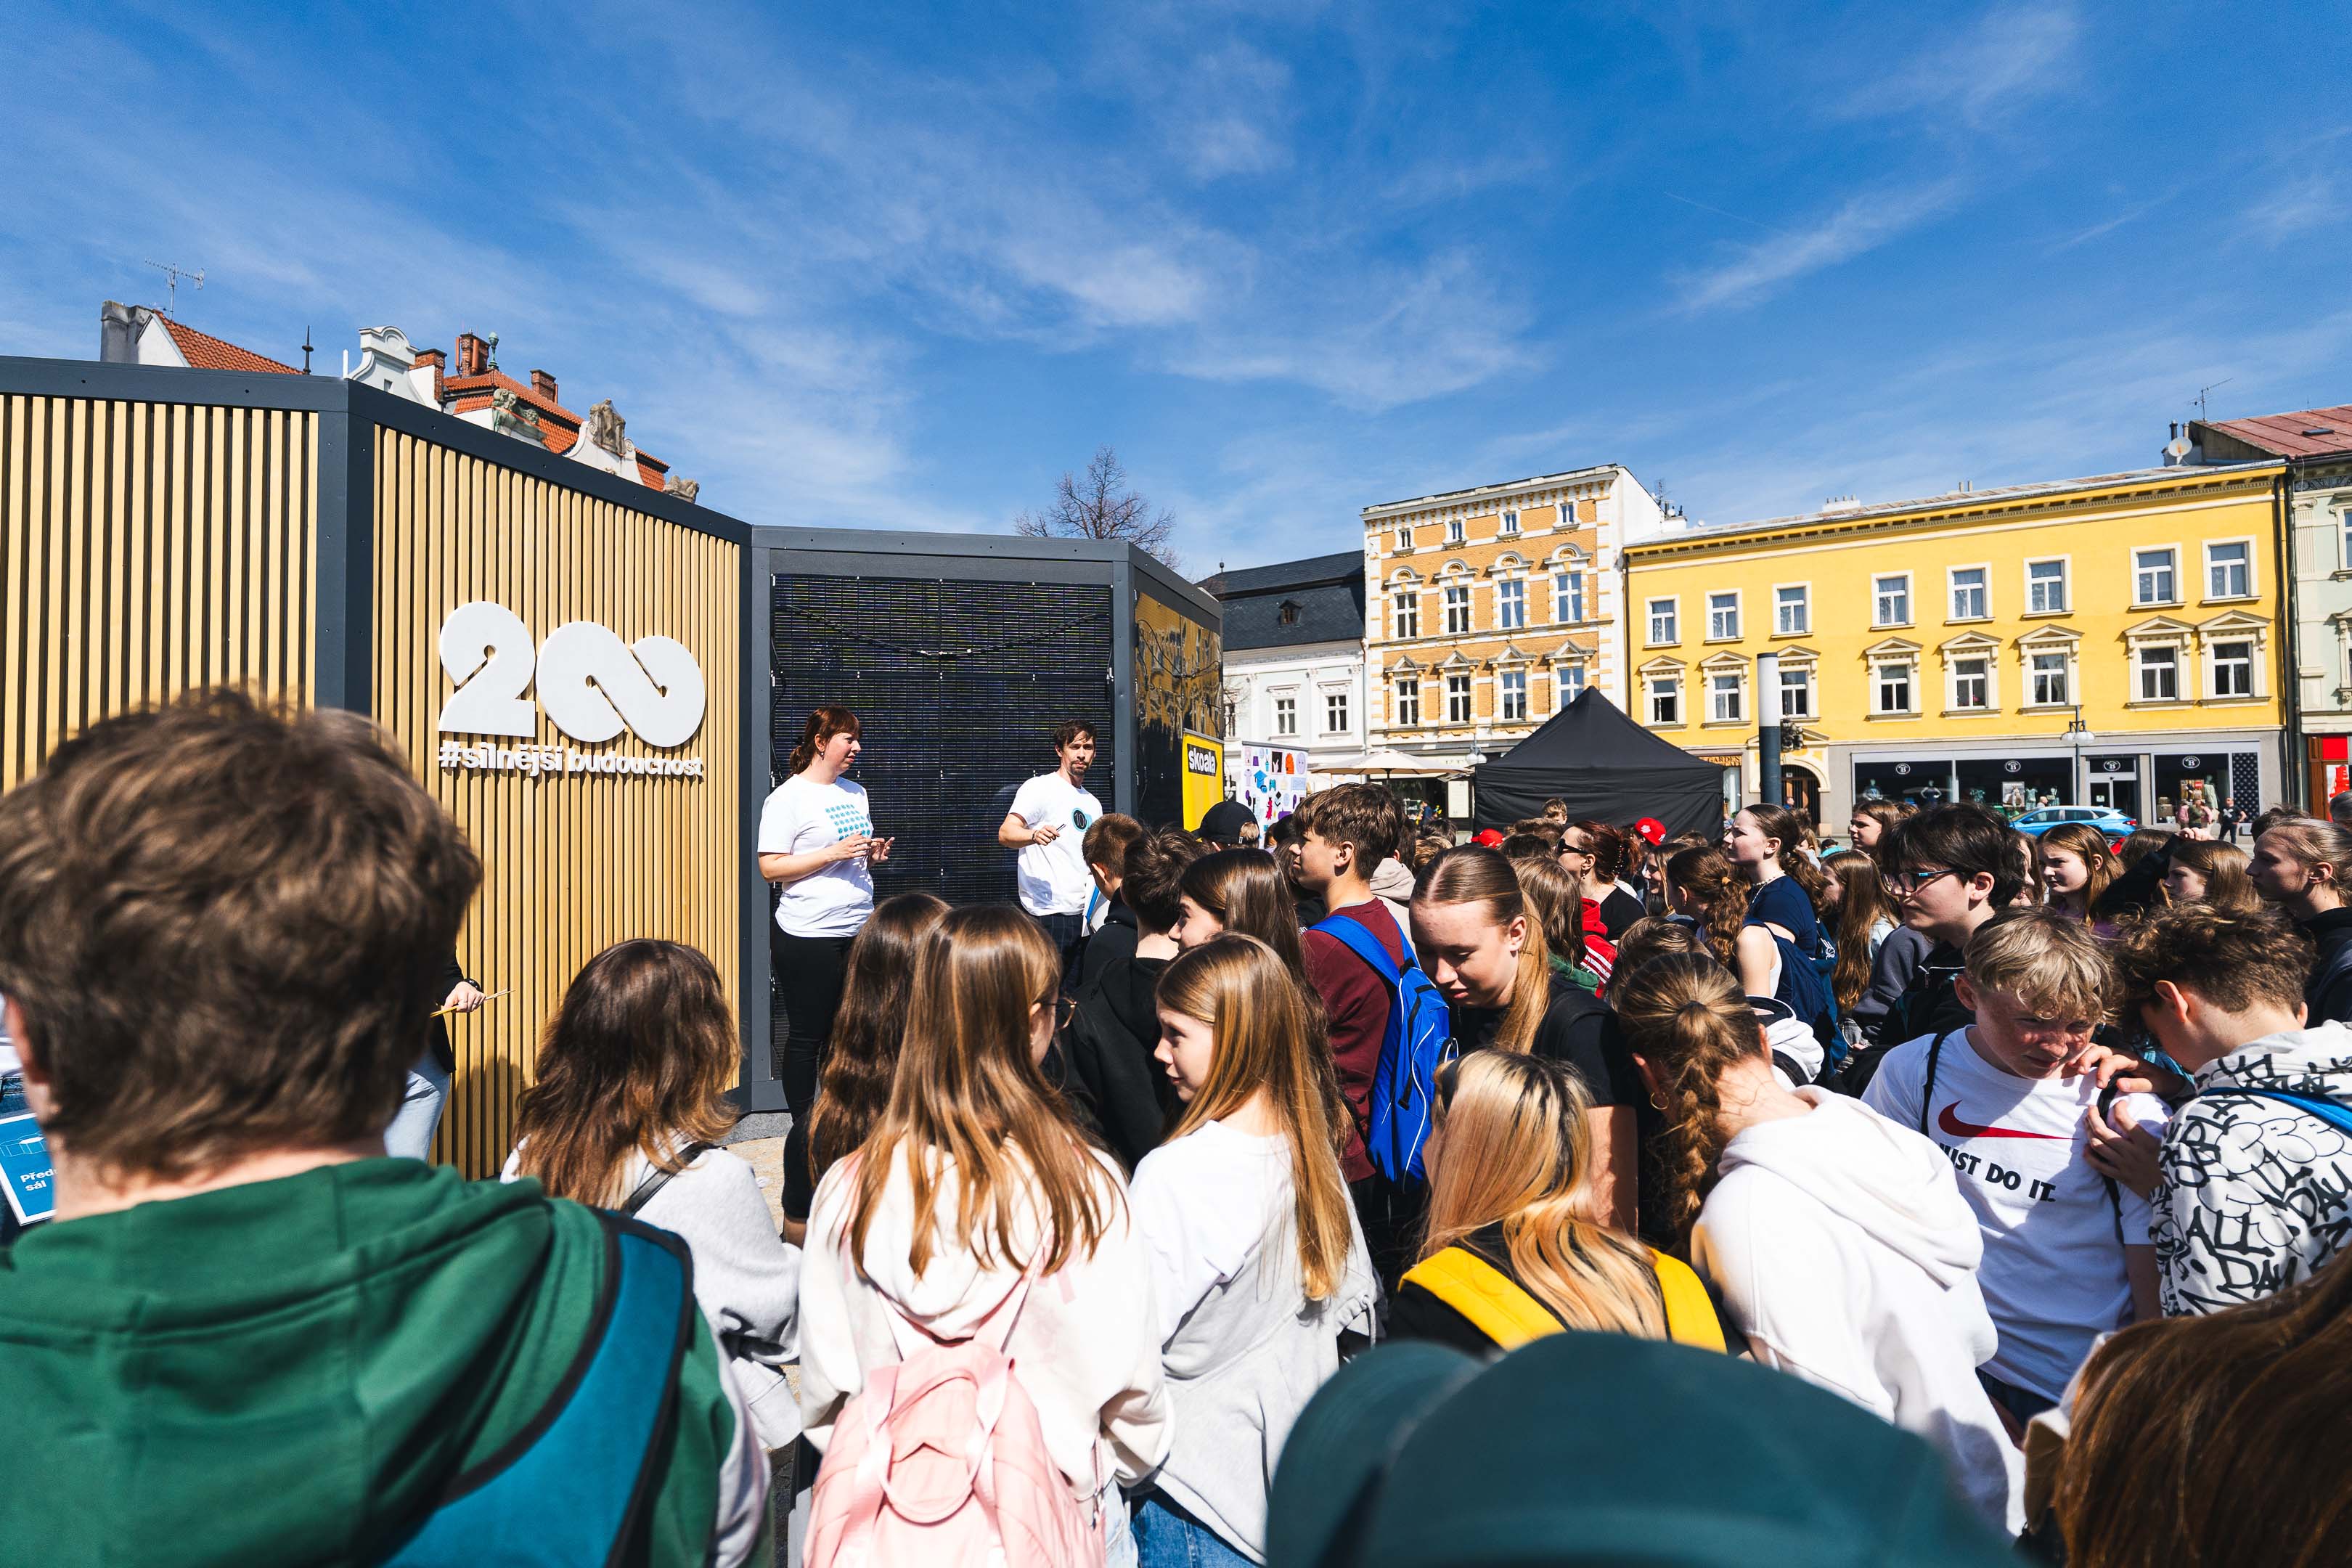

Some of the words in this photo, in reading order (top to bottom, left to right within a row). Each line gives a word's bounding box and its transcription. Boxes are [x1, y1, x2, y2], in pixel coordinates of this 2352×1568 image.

[568, 749, 703, 777] budoucnost
[1188, 747, 1217, 774] skoala
[25, 1180, 47, 1191] sál
[1985, 1162, 2022, 1191] DO
[2028, 1178, 2057, 1202] IT.
